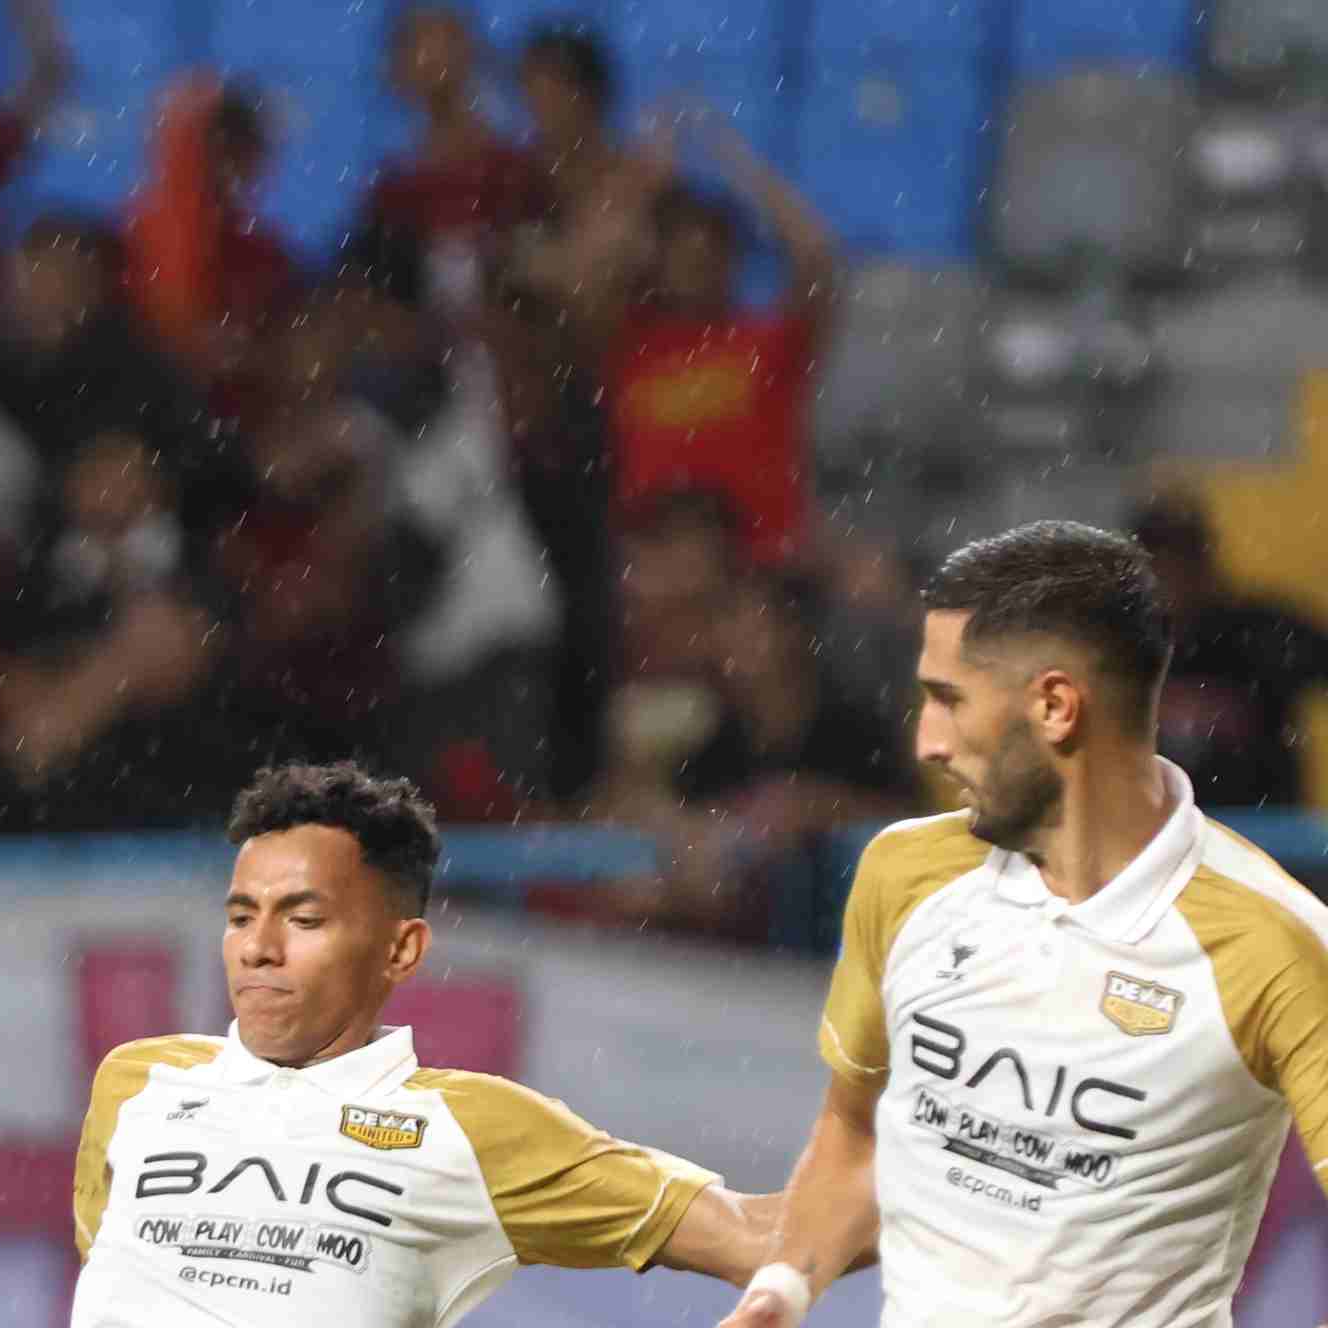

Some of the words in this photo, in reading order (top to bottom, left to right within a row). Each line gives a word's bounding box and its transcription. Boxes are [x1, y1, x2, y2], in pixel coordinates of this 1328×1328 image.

[911, 1012, 1147, 1140] BAIC
[914, 1089, 949, 1127] COW
[959, 1112, 1000, 1140] PLAY
[1013, 1131, 1055, 1163] COW
[1064, 1151, 1112, 1183] MOO
[136, 1151, 404, 1227] BAIC
[946, 1166, 1042, 1212] @cpcm.id
[138, 1219, 183, 1244] COW
[195, 1220, 245, 1244] PLAY
[257, 1223, 304, 1250] COW
[317, 1233, 363, 1265] MOO
[178, 1265, 293, 1296] @cpcm.id
